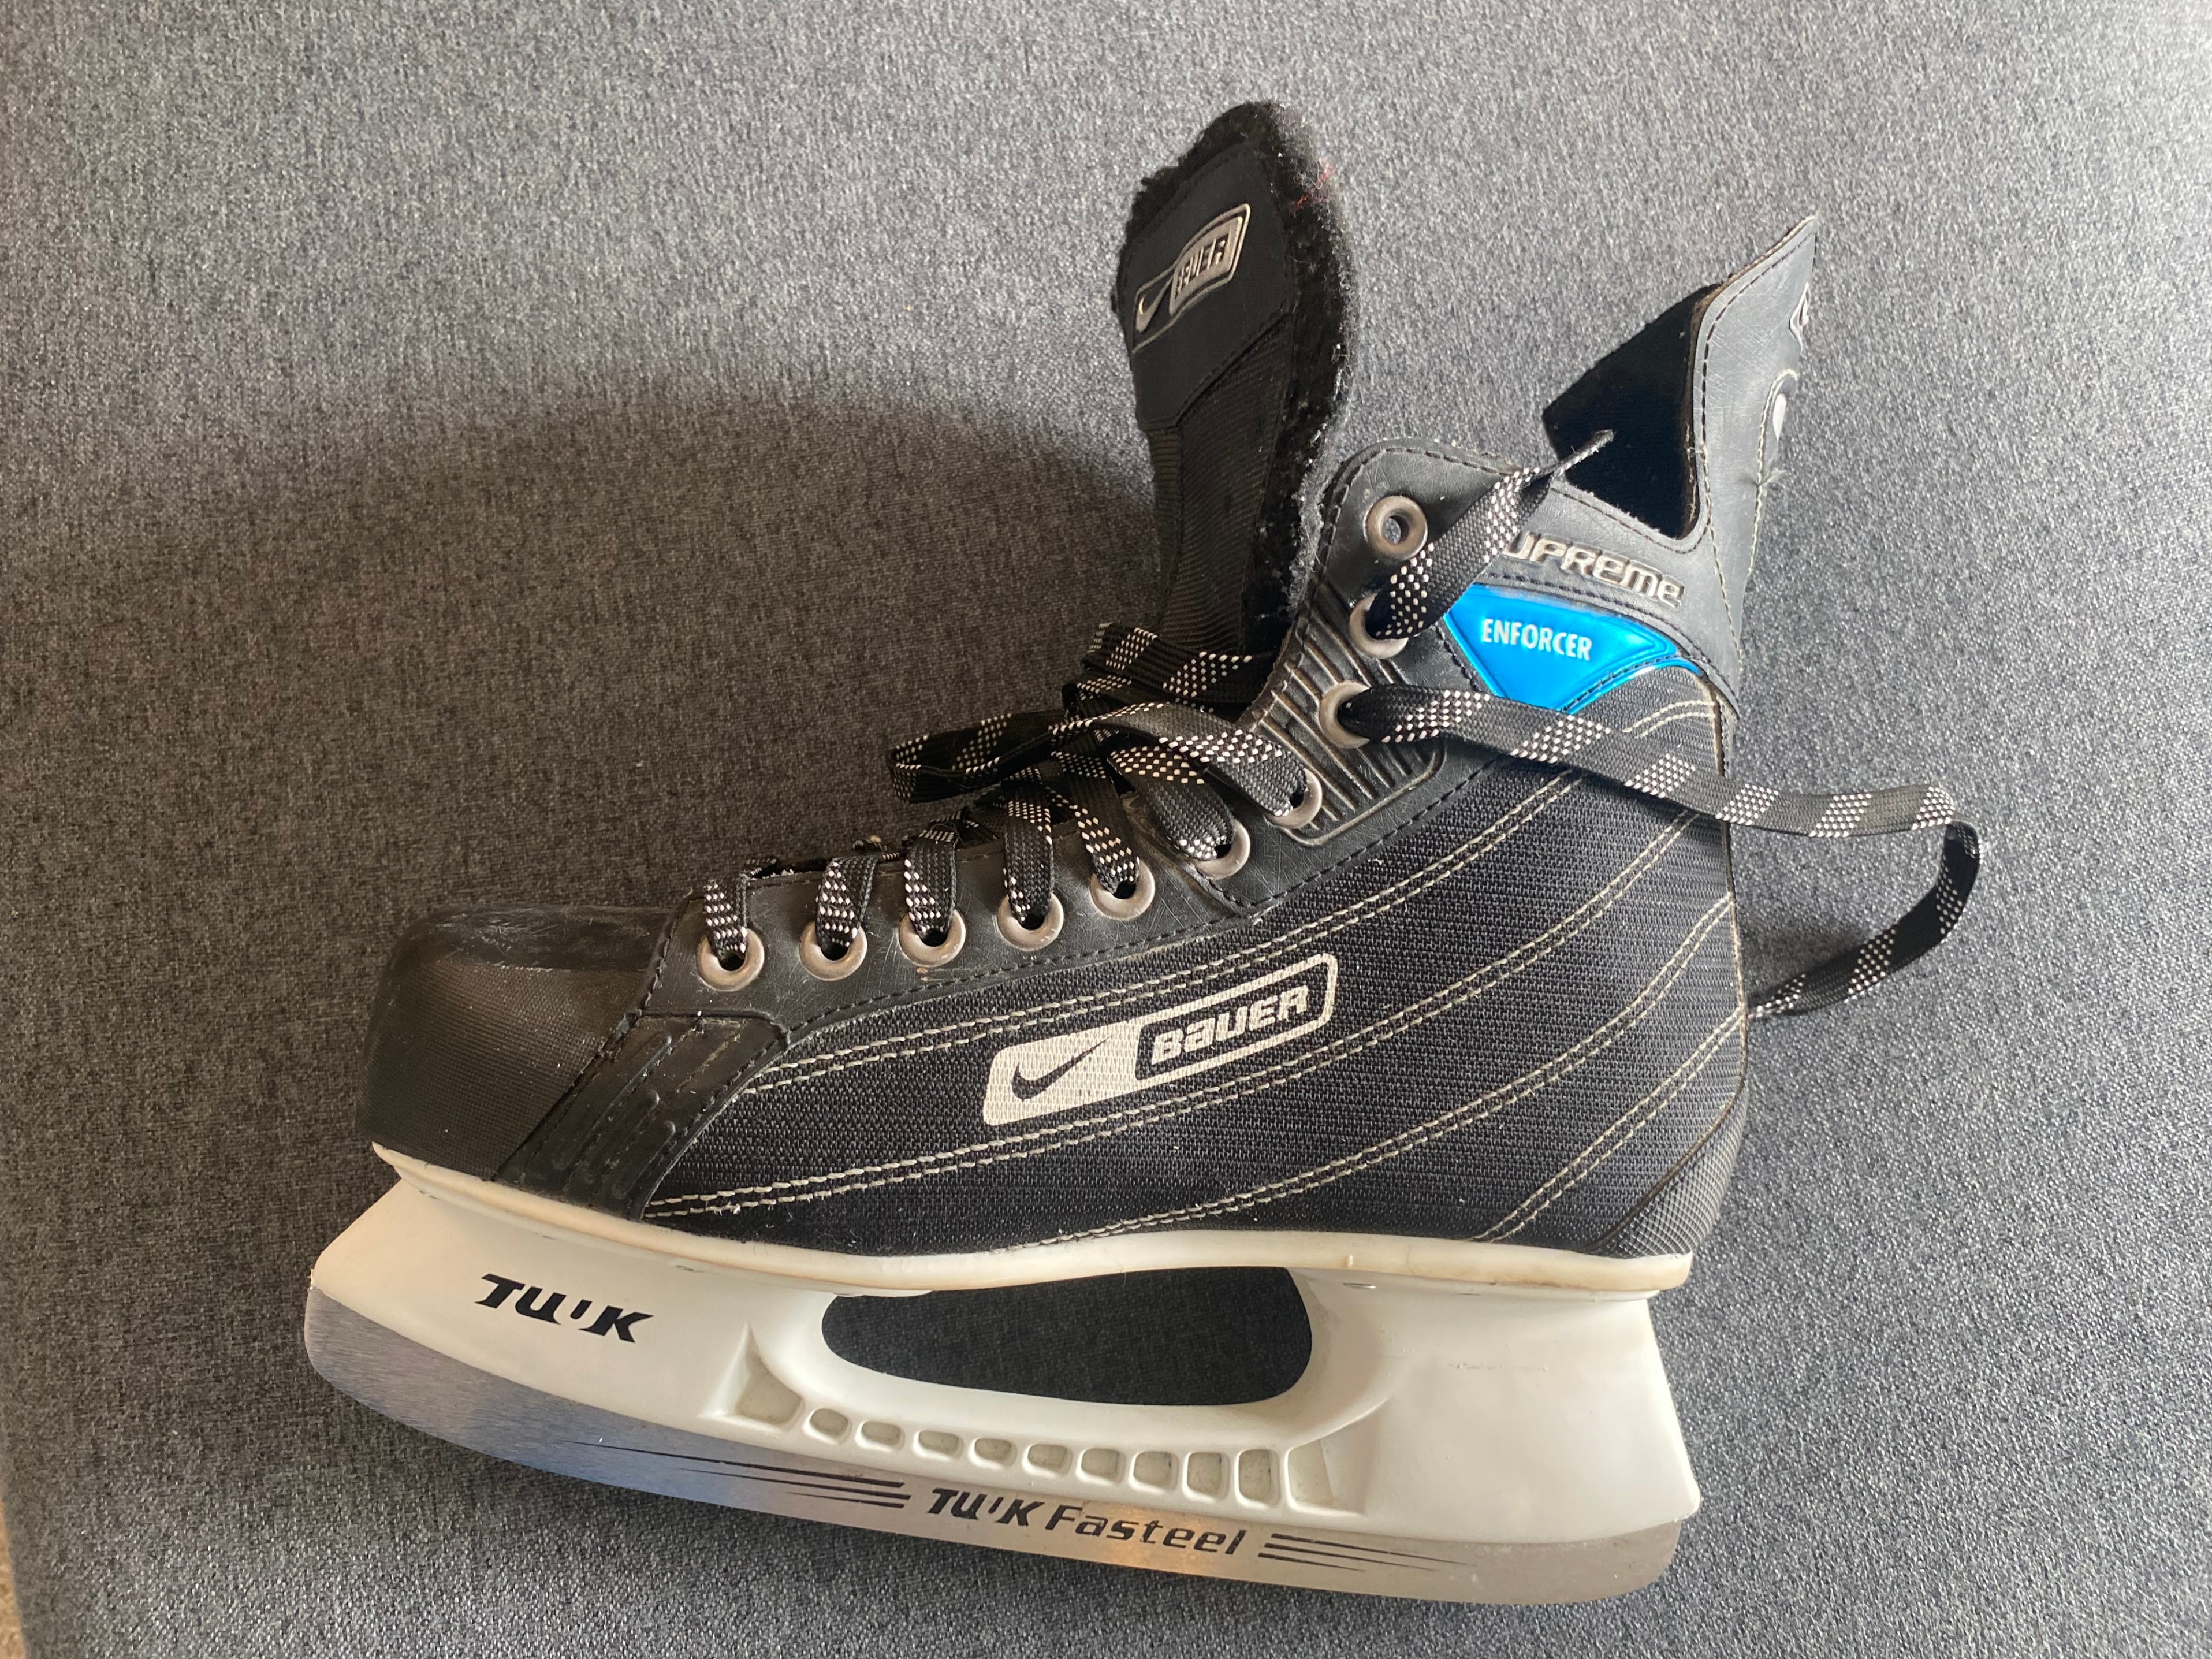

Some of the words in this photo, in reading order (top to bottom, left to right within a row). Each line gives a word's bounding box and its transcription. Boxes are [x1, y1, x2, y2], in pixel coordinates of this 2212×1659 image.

[1503, 530, 1685, 608] UPREME
[1482, 618, 1593, 661] ENFORCER
[1044, 1504, 1247, 1555] Fasteel
